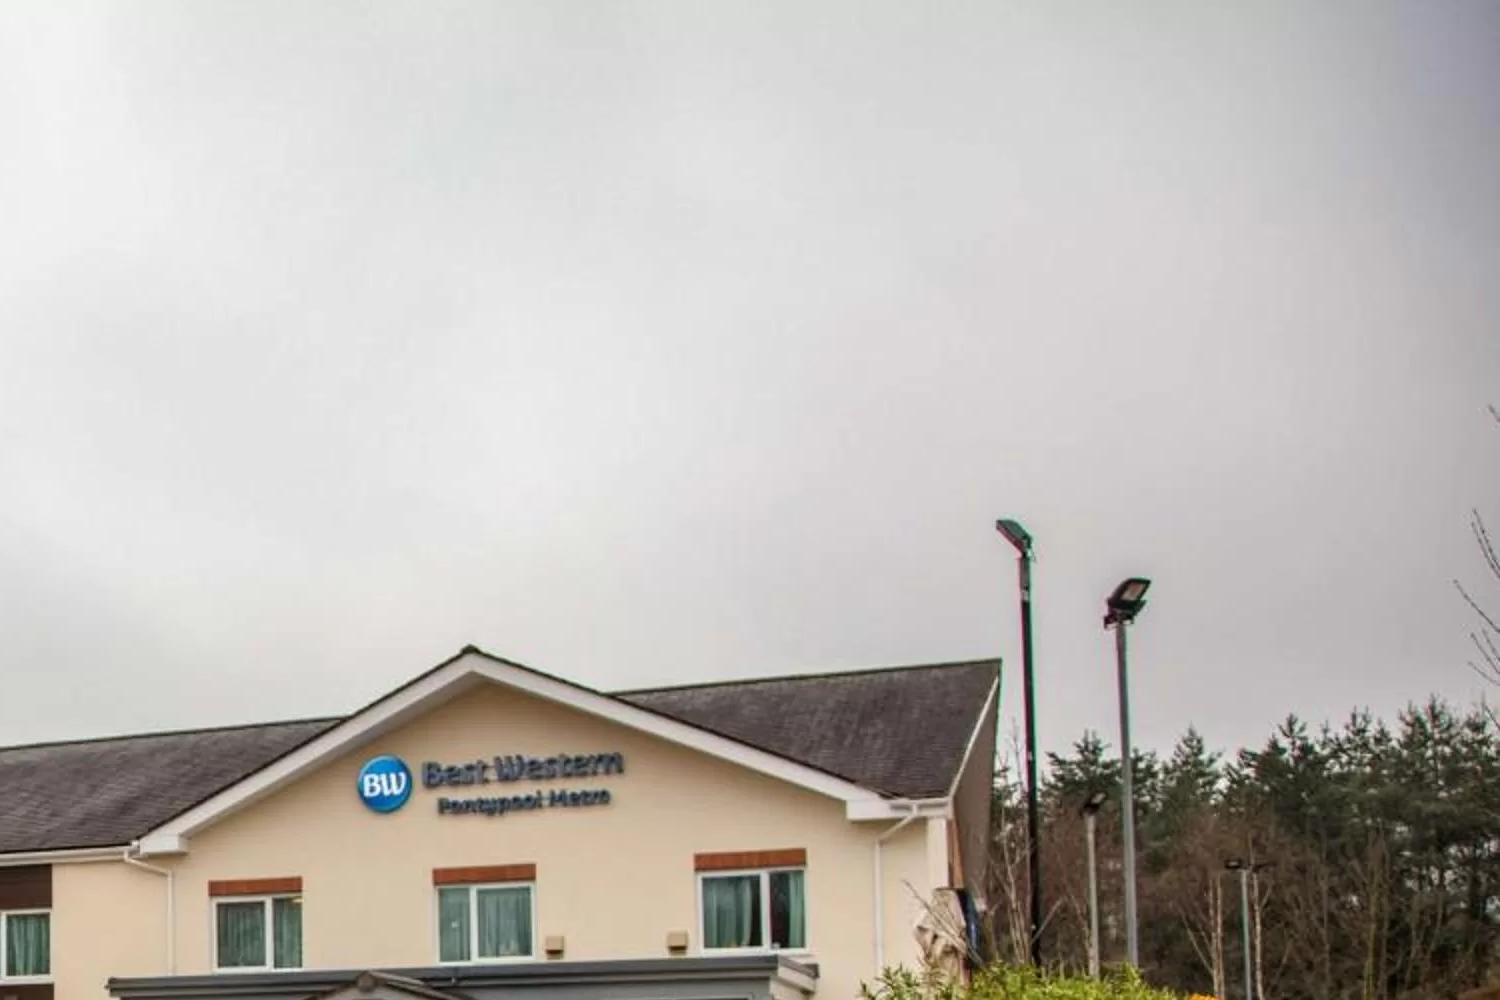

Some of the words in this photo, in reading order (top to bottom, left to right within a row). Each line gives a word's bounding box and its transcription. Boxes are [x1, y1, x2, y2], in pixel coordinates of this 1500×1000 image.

[363, 771, 406, 797] BW
[422, 759, 488, 789] Best
[493, 752, 624, 780] Western
[438, 789, 542, 817] Pontypool
